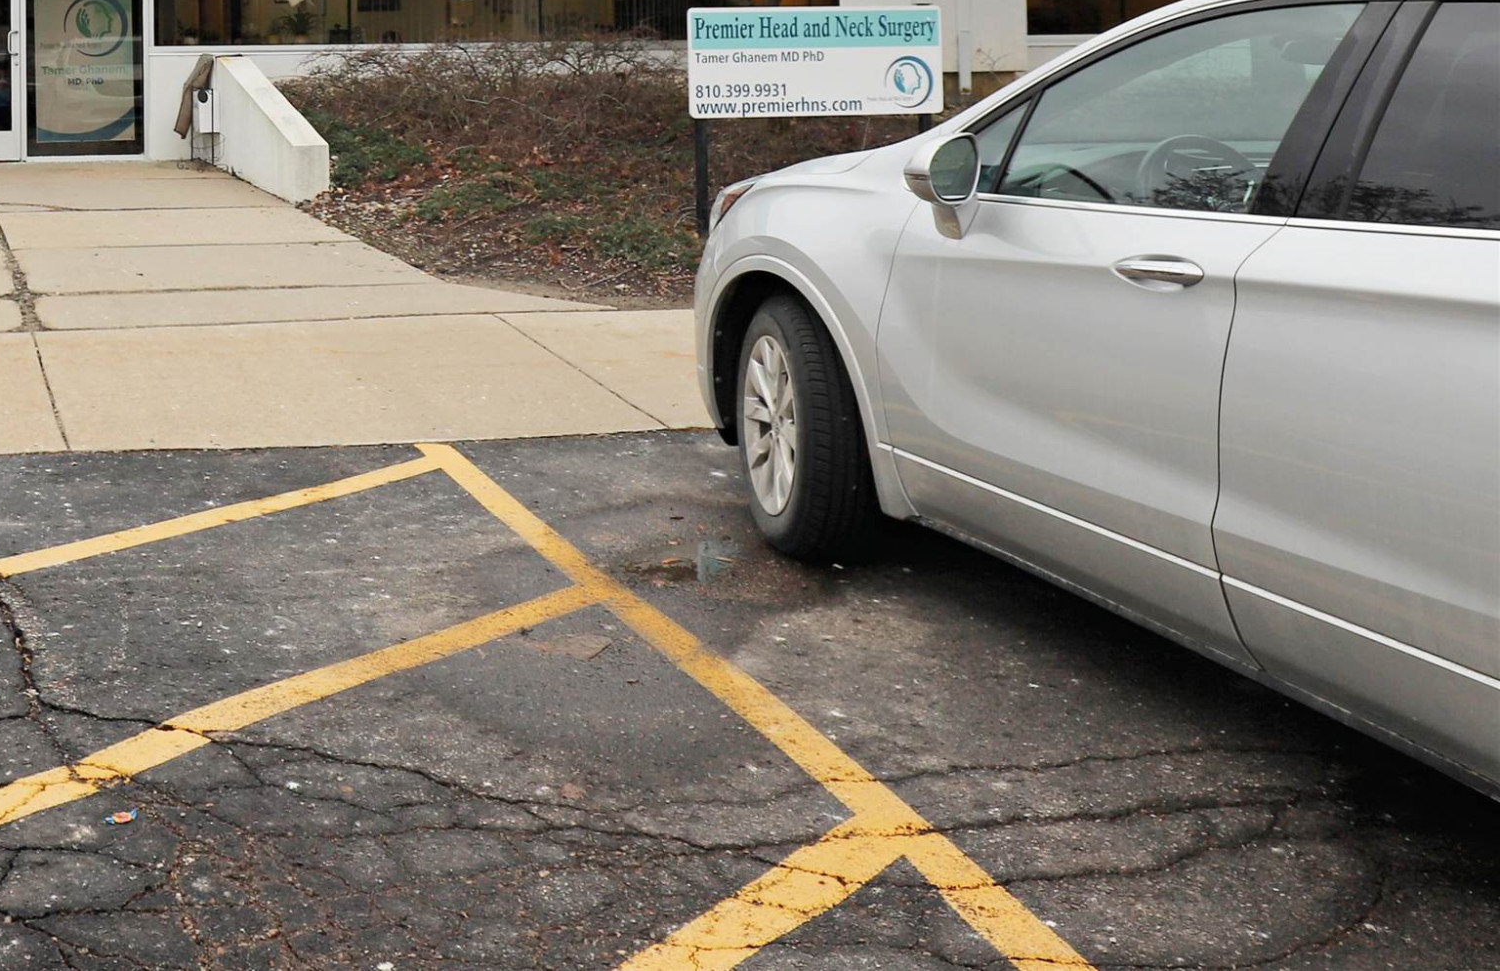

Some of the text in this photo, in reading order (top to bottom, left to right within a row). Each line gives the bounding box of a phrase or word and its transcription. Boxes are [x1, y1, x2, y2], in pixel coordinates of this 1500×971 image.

[693, 14, 936, 42] Premier Head and Neck Surgery
[695, 51, 824, 64] Tamer Ghanem MD PhD
[40, 65, 75, 76] Tamer
[695, 83, 788, 99] 810.399.9931
[696, 97, 863, 117] www.premierhns.com
